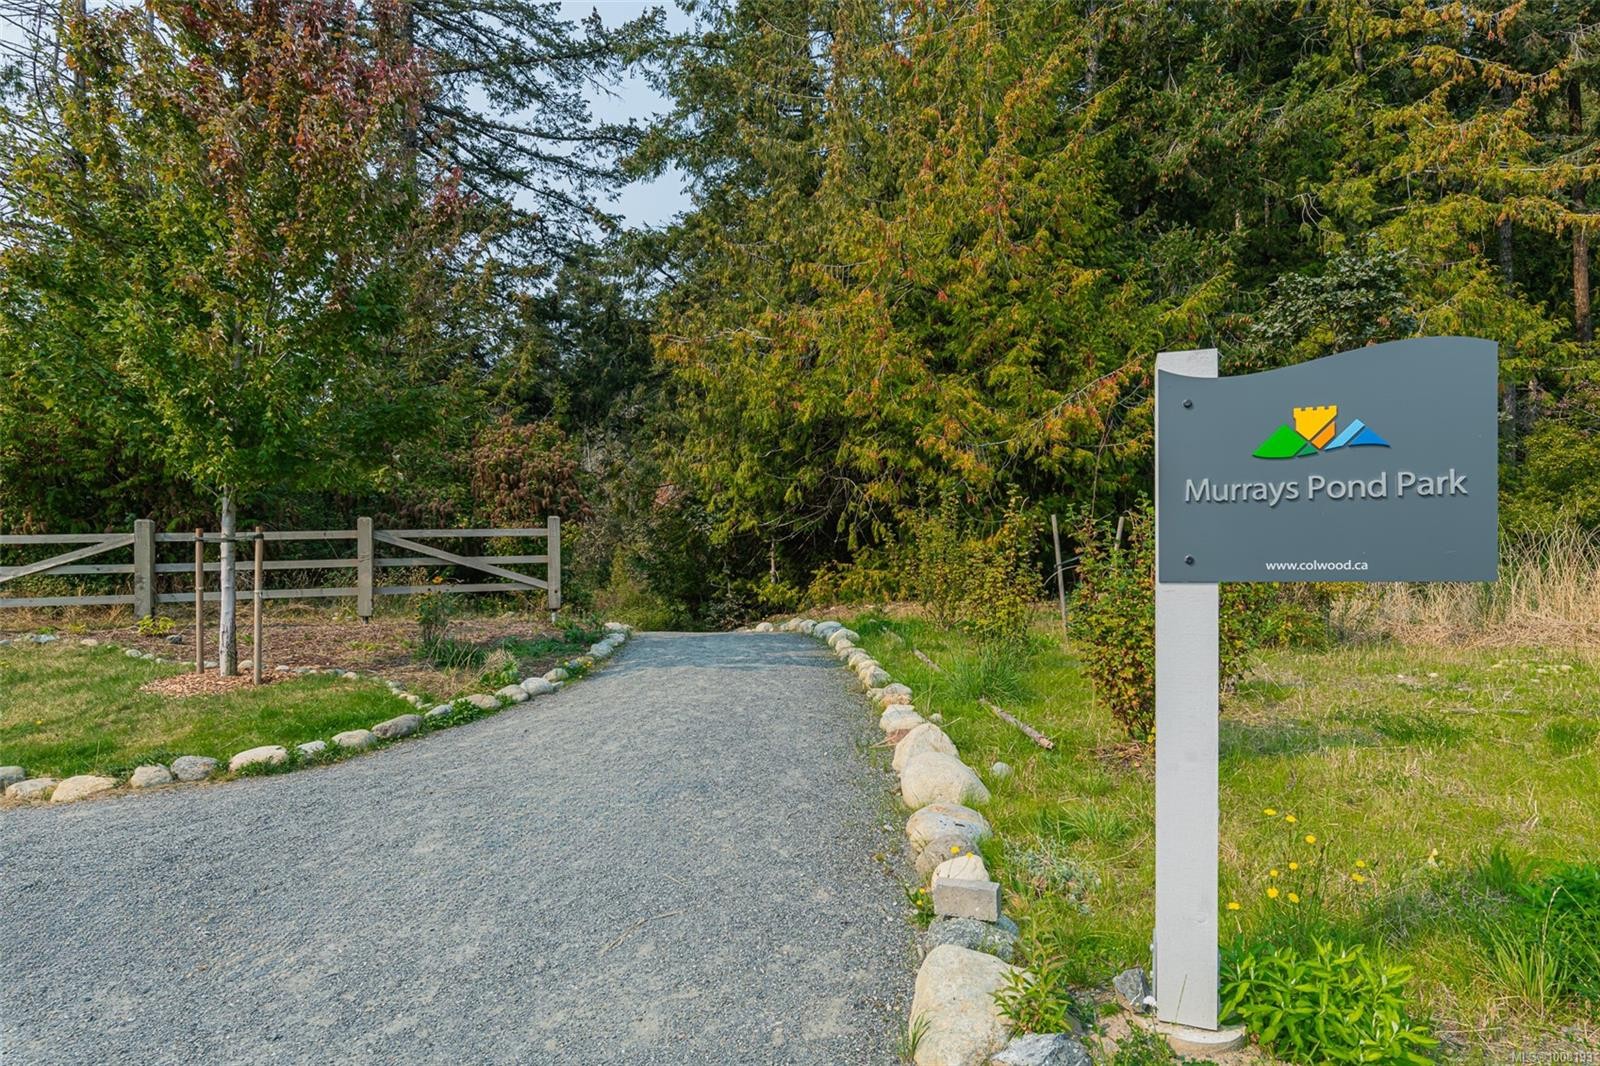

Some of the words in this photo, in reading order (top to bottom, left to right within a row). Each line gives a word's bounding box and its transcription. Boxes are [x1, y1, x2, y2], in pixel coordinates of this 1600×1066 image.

[1184, 477, 1300, 507] Murrays
[1307, 471, 1388, 500] Pond
[1397, 468, 1470, 497] Park
[1265, 559, 1369, 571] www.colwood.ca
